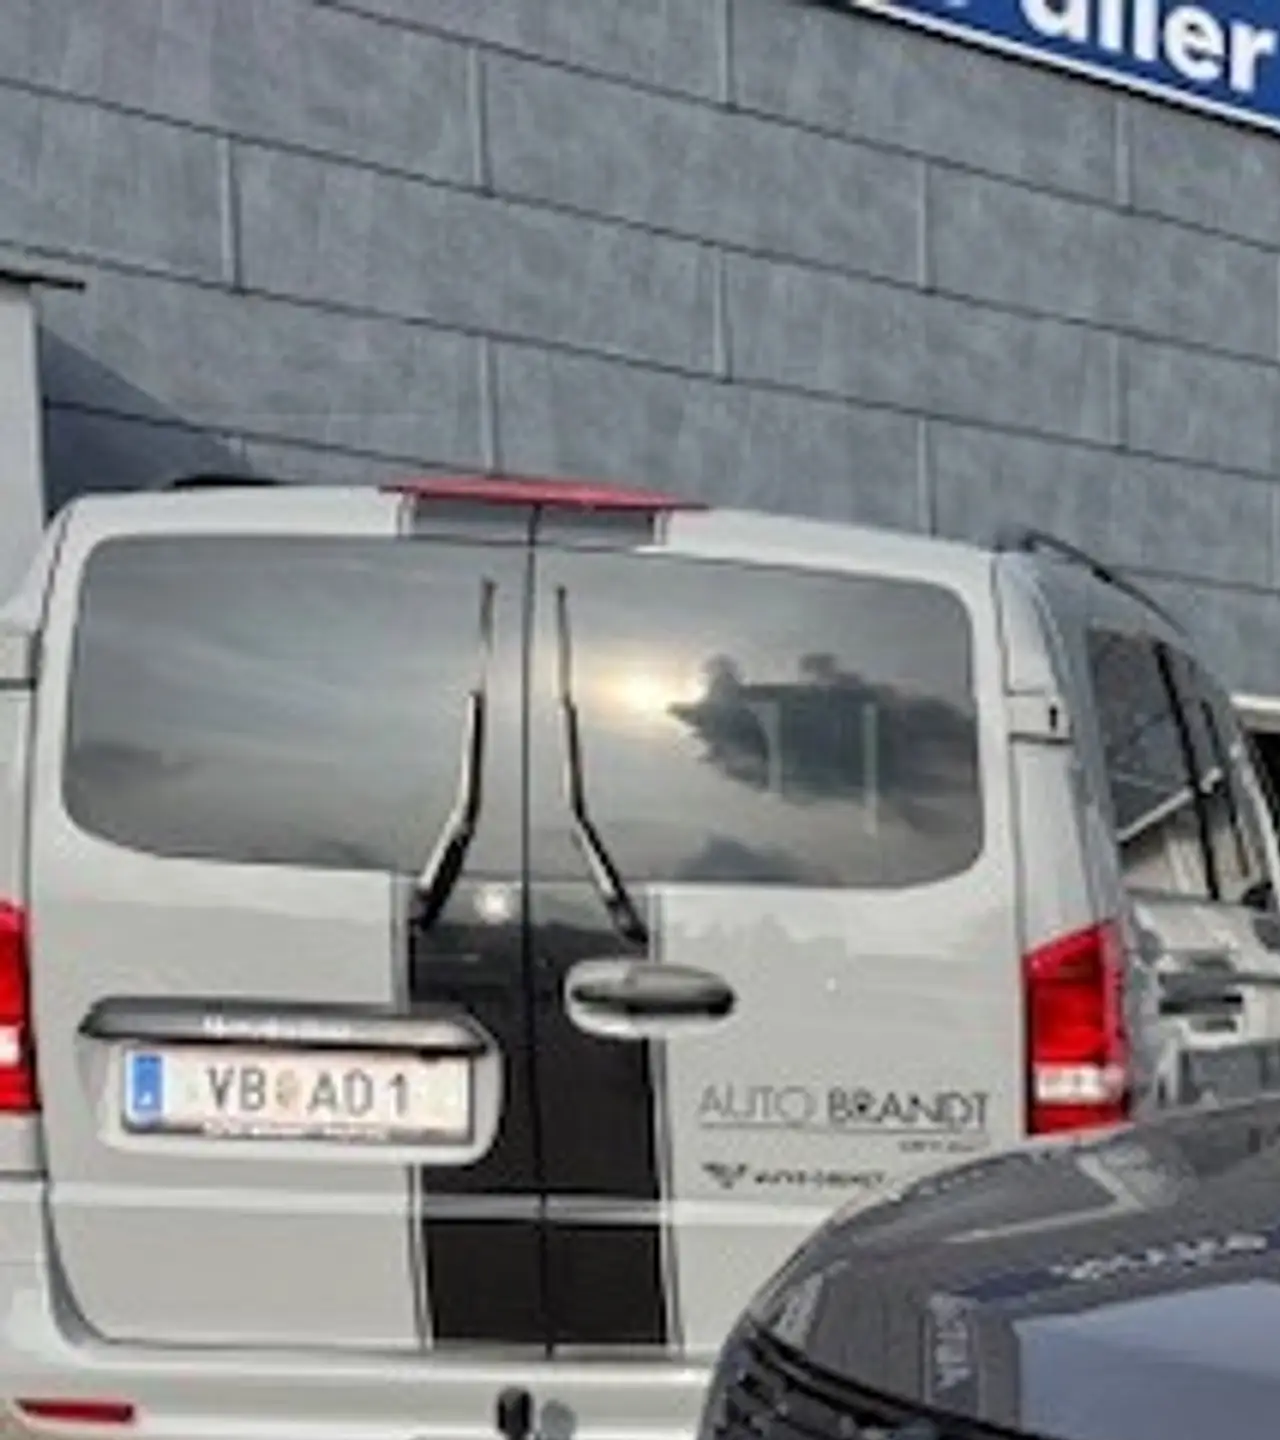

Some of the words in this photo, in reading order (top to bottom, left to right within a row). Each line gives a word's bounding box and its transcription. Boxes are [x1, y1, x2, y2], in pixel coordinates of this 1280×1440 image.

[206, 1065, 266, 1112] VB
[699, 1082, 818, 1122] AUTO
[827, 1085, 989, 1127] BRANDT
